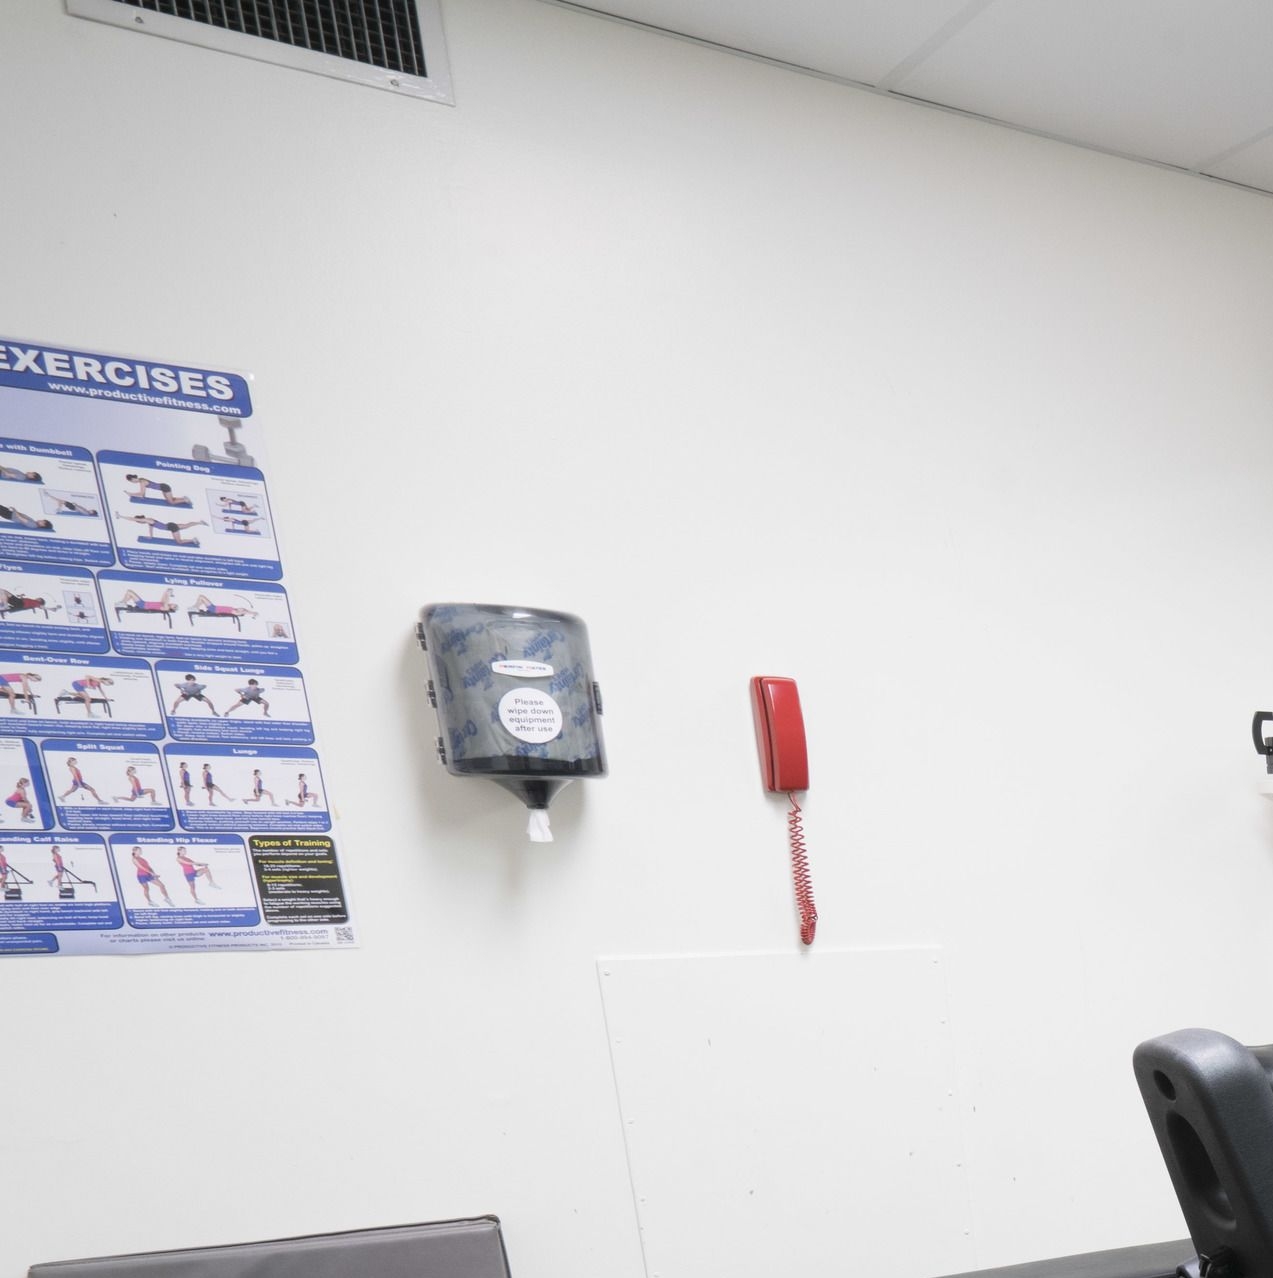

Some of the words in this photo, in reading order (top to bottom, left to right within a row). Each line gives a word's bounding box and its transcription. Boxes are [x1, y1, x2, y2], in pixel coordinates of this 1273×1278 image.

[48, 382, 242, 415] www.productivefitness.com
[29, 446, 73, 457] Dumbbell
[156, 460, 191, 471] Pointing
[193, 464, 211, 474] Dog
[165, 576, 189, 587] Lying
[190, 579, 224, 588] Pullover
[23, 655, 68, 665] Bent-Over
[70, 658, 90, 666] Row
[194, 664, 213, 673] Side
[215, 665, 239, 674] Squat
[240, 667, 265, 676] Lunge
[514, 698, 544, 706] Please
[507, 708, 528, 716] wipe
[530, 707, 554, 715] down
[509, 717, 555, 725] equipment
[77, 743, 98, 751] Split
[99, 744, 125, 752] Squat
[232, 748, 258, 756] Lunge
[136, 836, 175, 844] Standing
[176, 836, 191, 845] Hip
[252, 840, 281, 848] Types
[294, 840, 332, 848] Training
[208, 929, 329, 938] www.productivefitness.com
